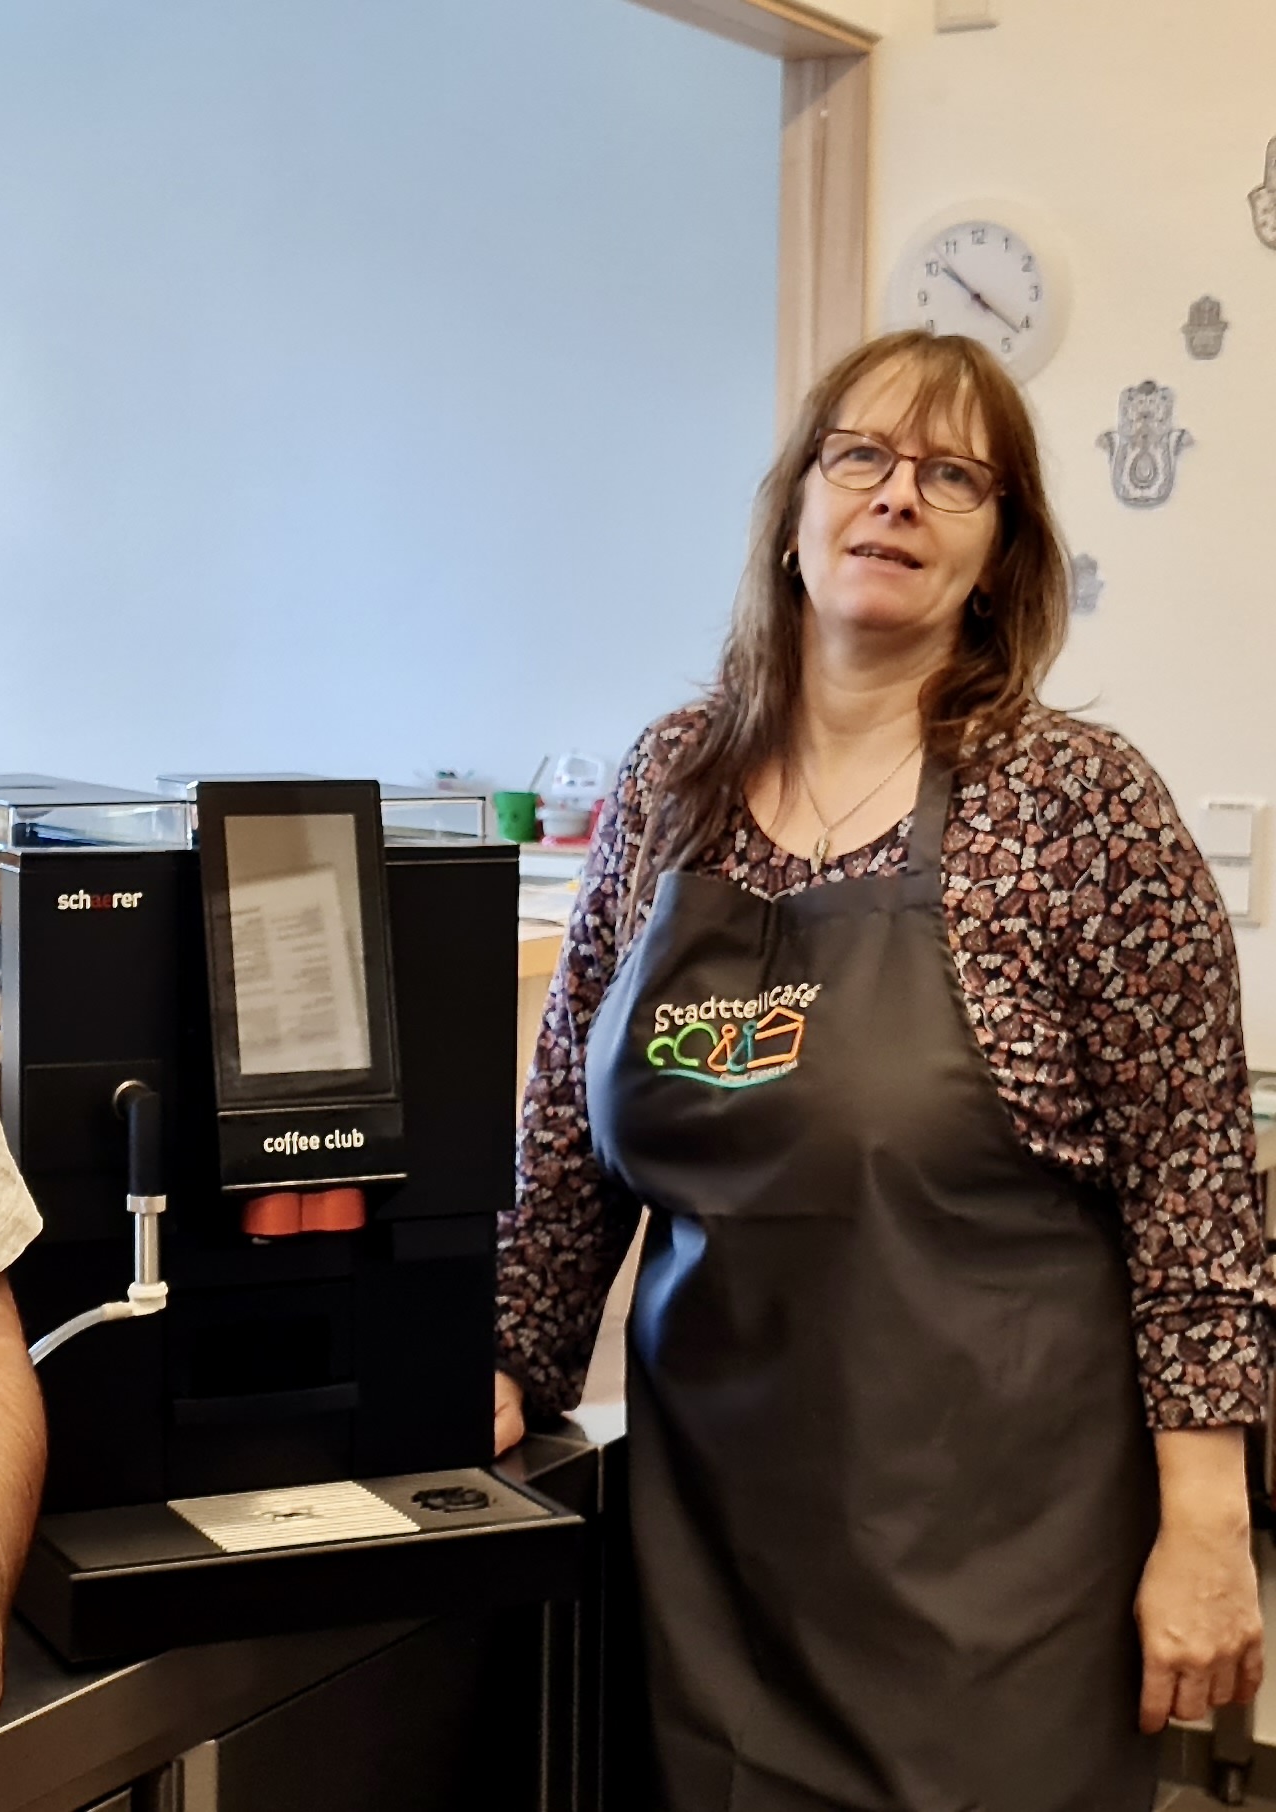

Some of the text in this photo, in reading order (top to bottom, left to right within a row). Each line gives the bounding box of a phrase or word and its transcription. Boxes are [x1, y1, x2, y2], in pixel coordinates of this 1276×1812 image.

[971, 228, 987, 245] 12
[944, 240, 958, 255] 11
[925, 260, 939, 277] 10
[1021, 255, 1033, 272] 2
[917, 290, 929, 307] 9
[1028, 285, 1040, 302] 3
[1020, 315, 1031, 329] 4
[1000, 337, 1012, 353] 5
[57, 889, 143, 910] schaerer
[263, 1128, 365, 1155] coffee club
